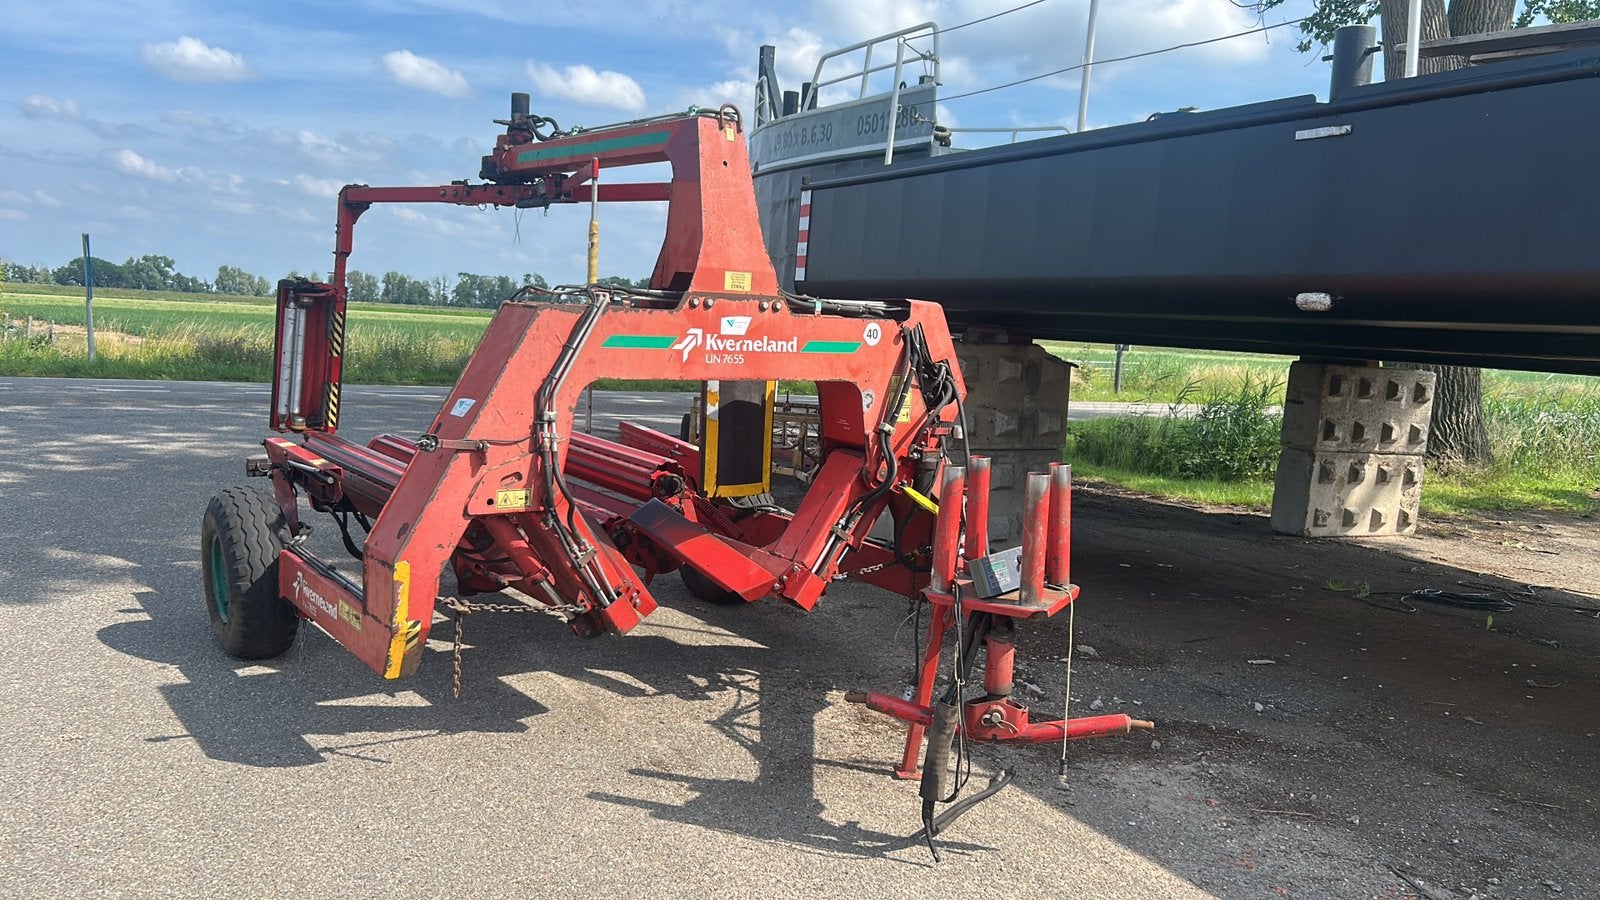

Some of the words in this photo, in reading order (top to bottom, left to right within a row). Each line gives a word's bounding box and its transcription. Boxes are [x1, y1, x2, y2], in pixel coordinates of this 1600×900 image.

[857, 105, 917, 136] 0501280
[867, 329, 878, 339] 40
[705, 333, 798, 352] Kverneland
[705, 354, 720, 364] UN
[722, 354, 744, 364] 7655
